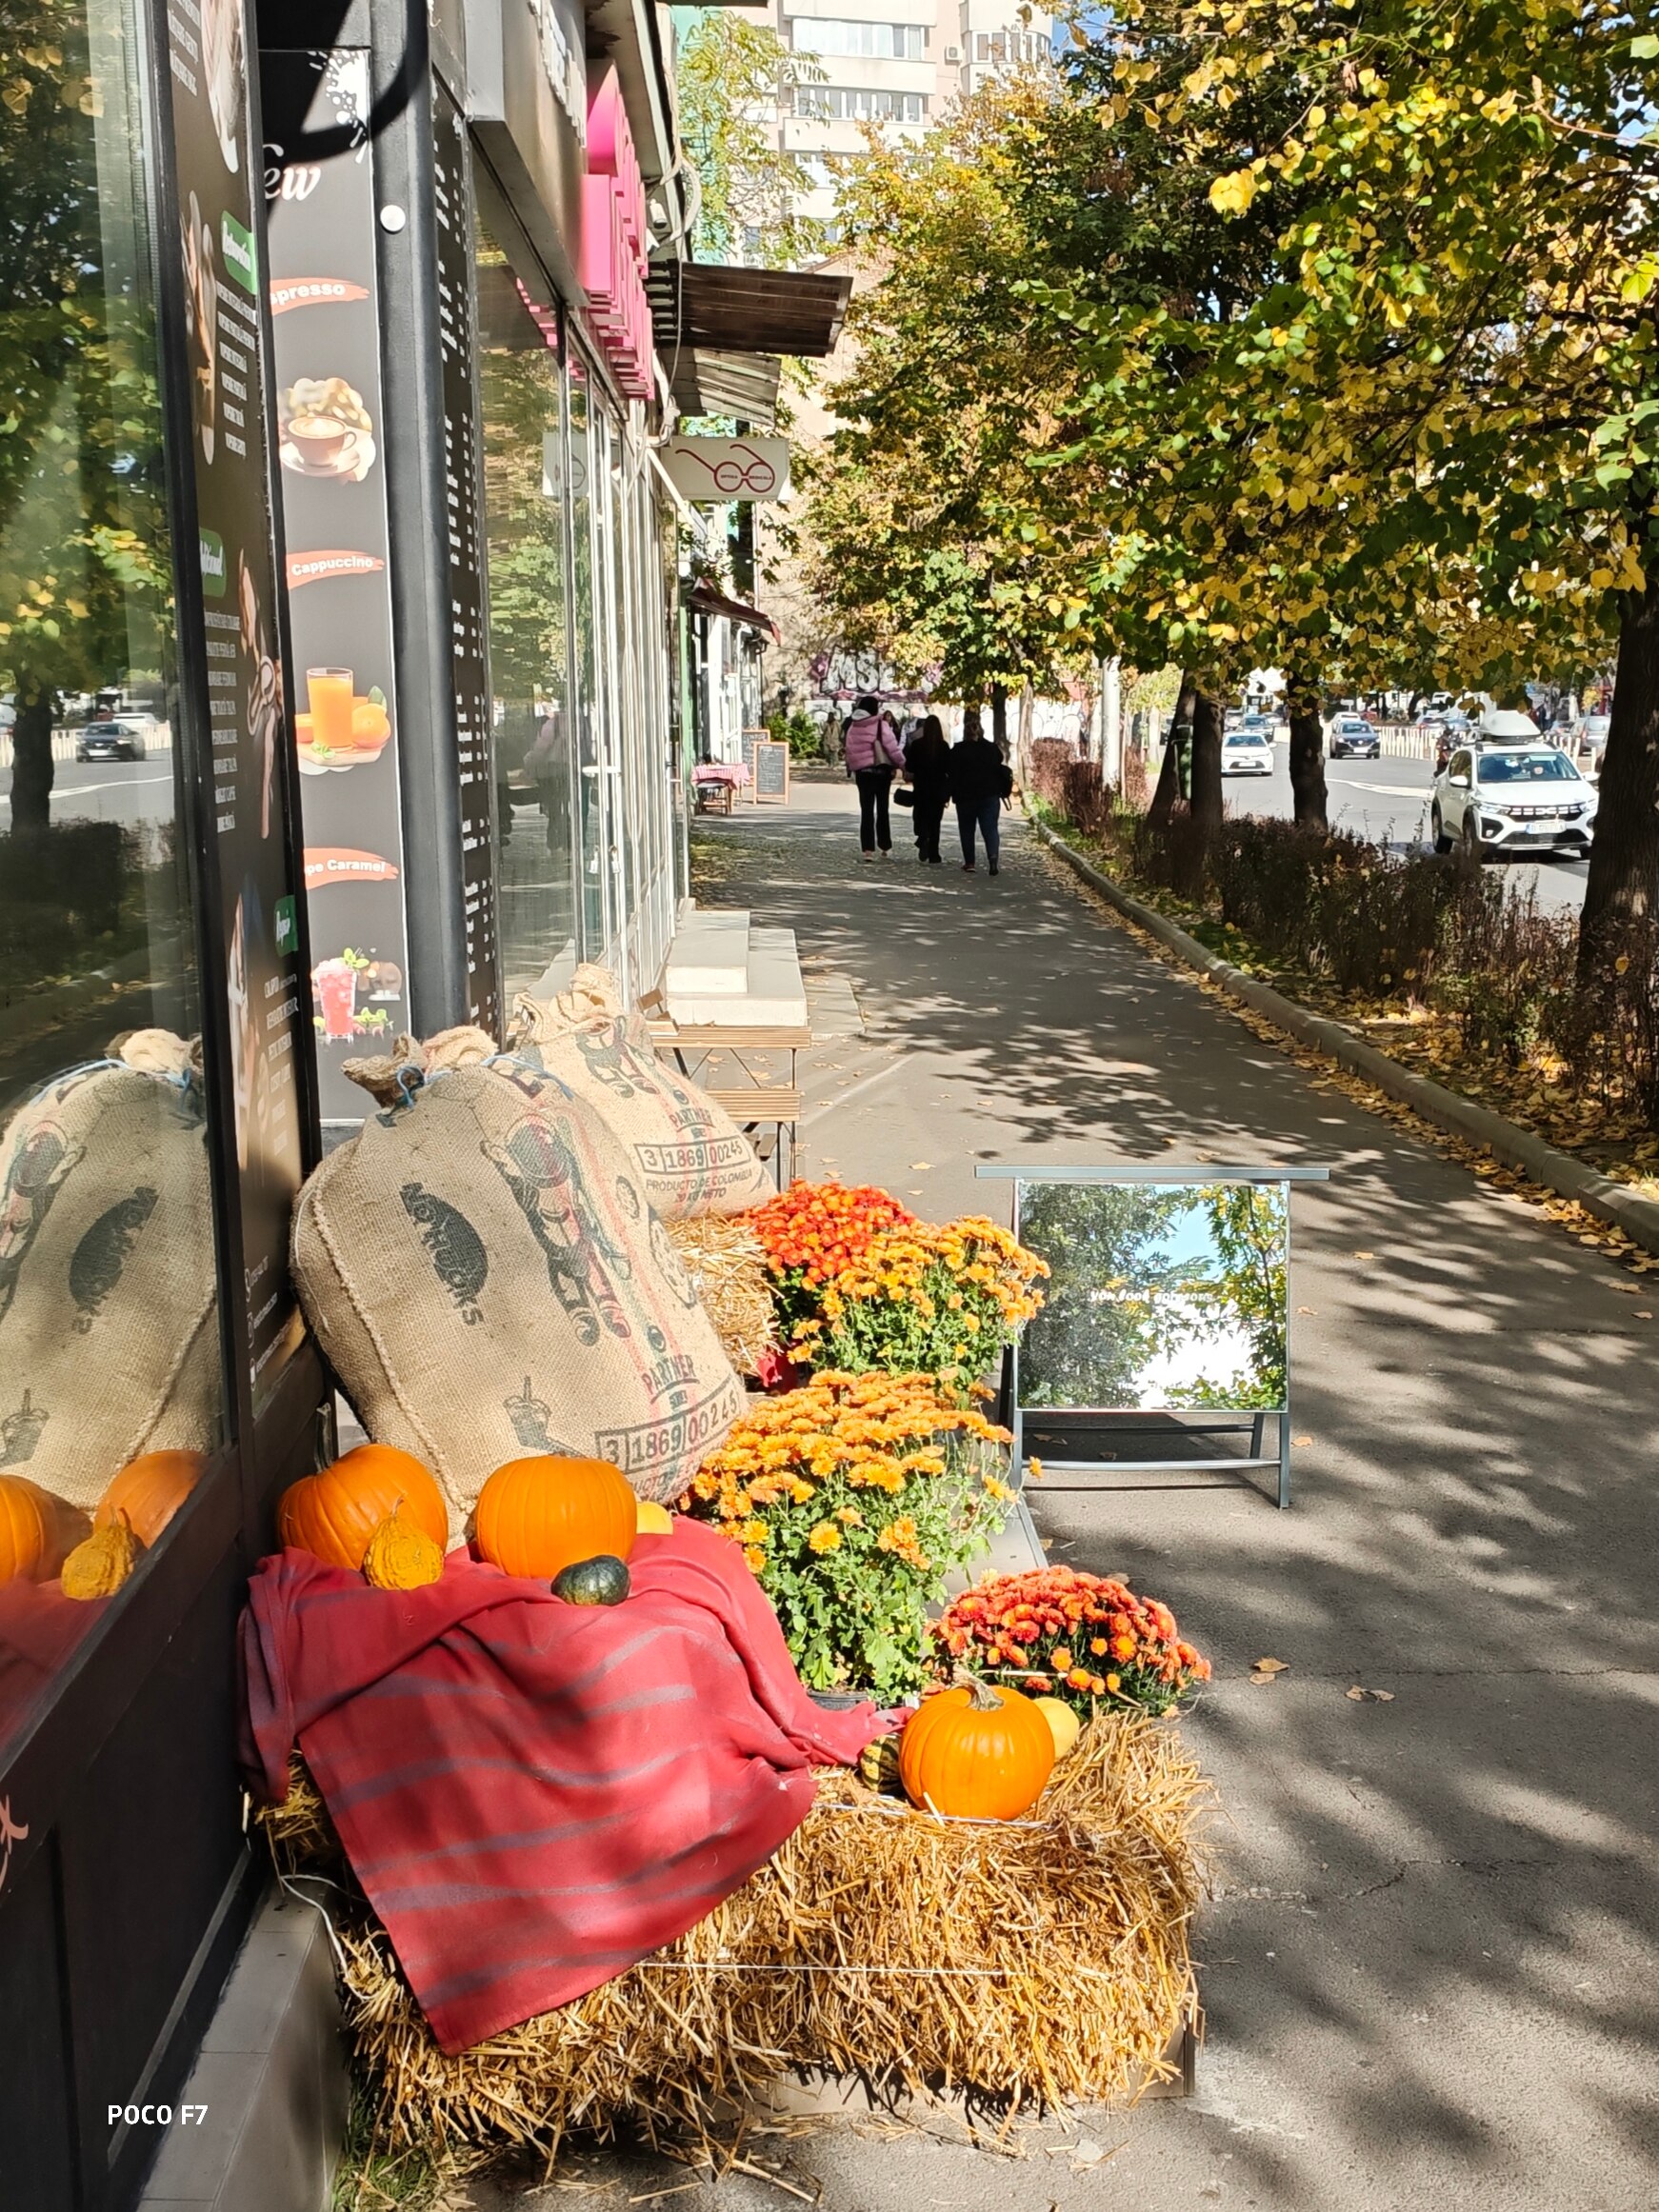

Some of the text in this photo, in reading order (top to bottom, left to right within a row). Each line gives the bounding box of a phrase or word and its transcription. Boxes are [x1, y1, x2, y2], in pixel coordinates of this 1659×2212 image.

[270, 283, 346, 306] spresso
[291, 556, 373, 576] Cappuccino
[327, 859, 387, 873] Caramel
[669, 1107, 713, 1128] PARTNER
[644, 1141, 742, 1168] 3 1869 00245
[646, 1168, 752, 1191] PRODUCTO DE COLOMBIA
[641, 1354, 696, 1395] PARTNER
[606, 1439, 619, 1465] 3
[631, 1424, 682, 1464] 1869
[689, 1390, 737, 1445] 00245
